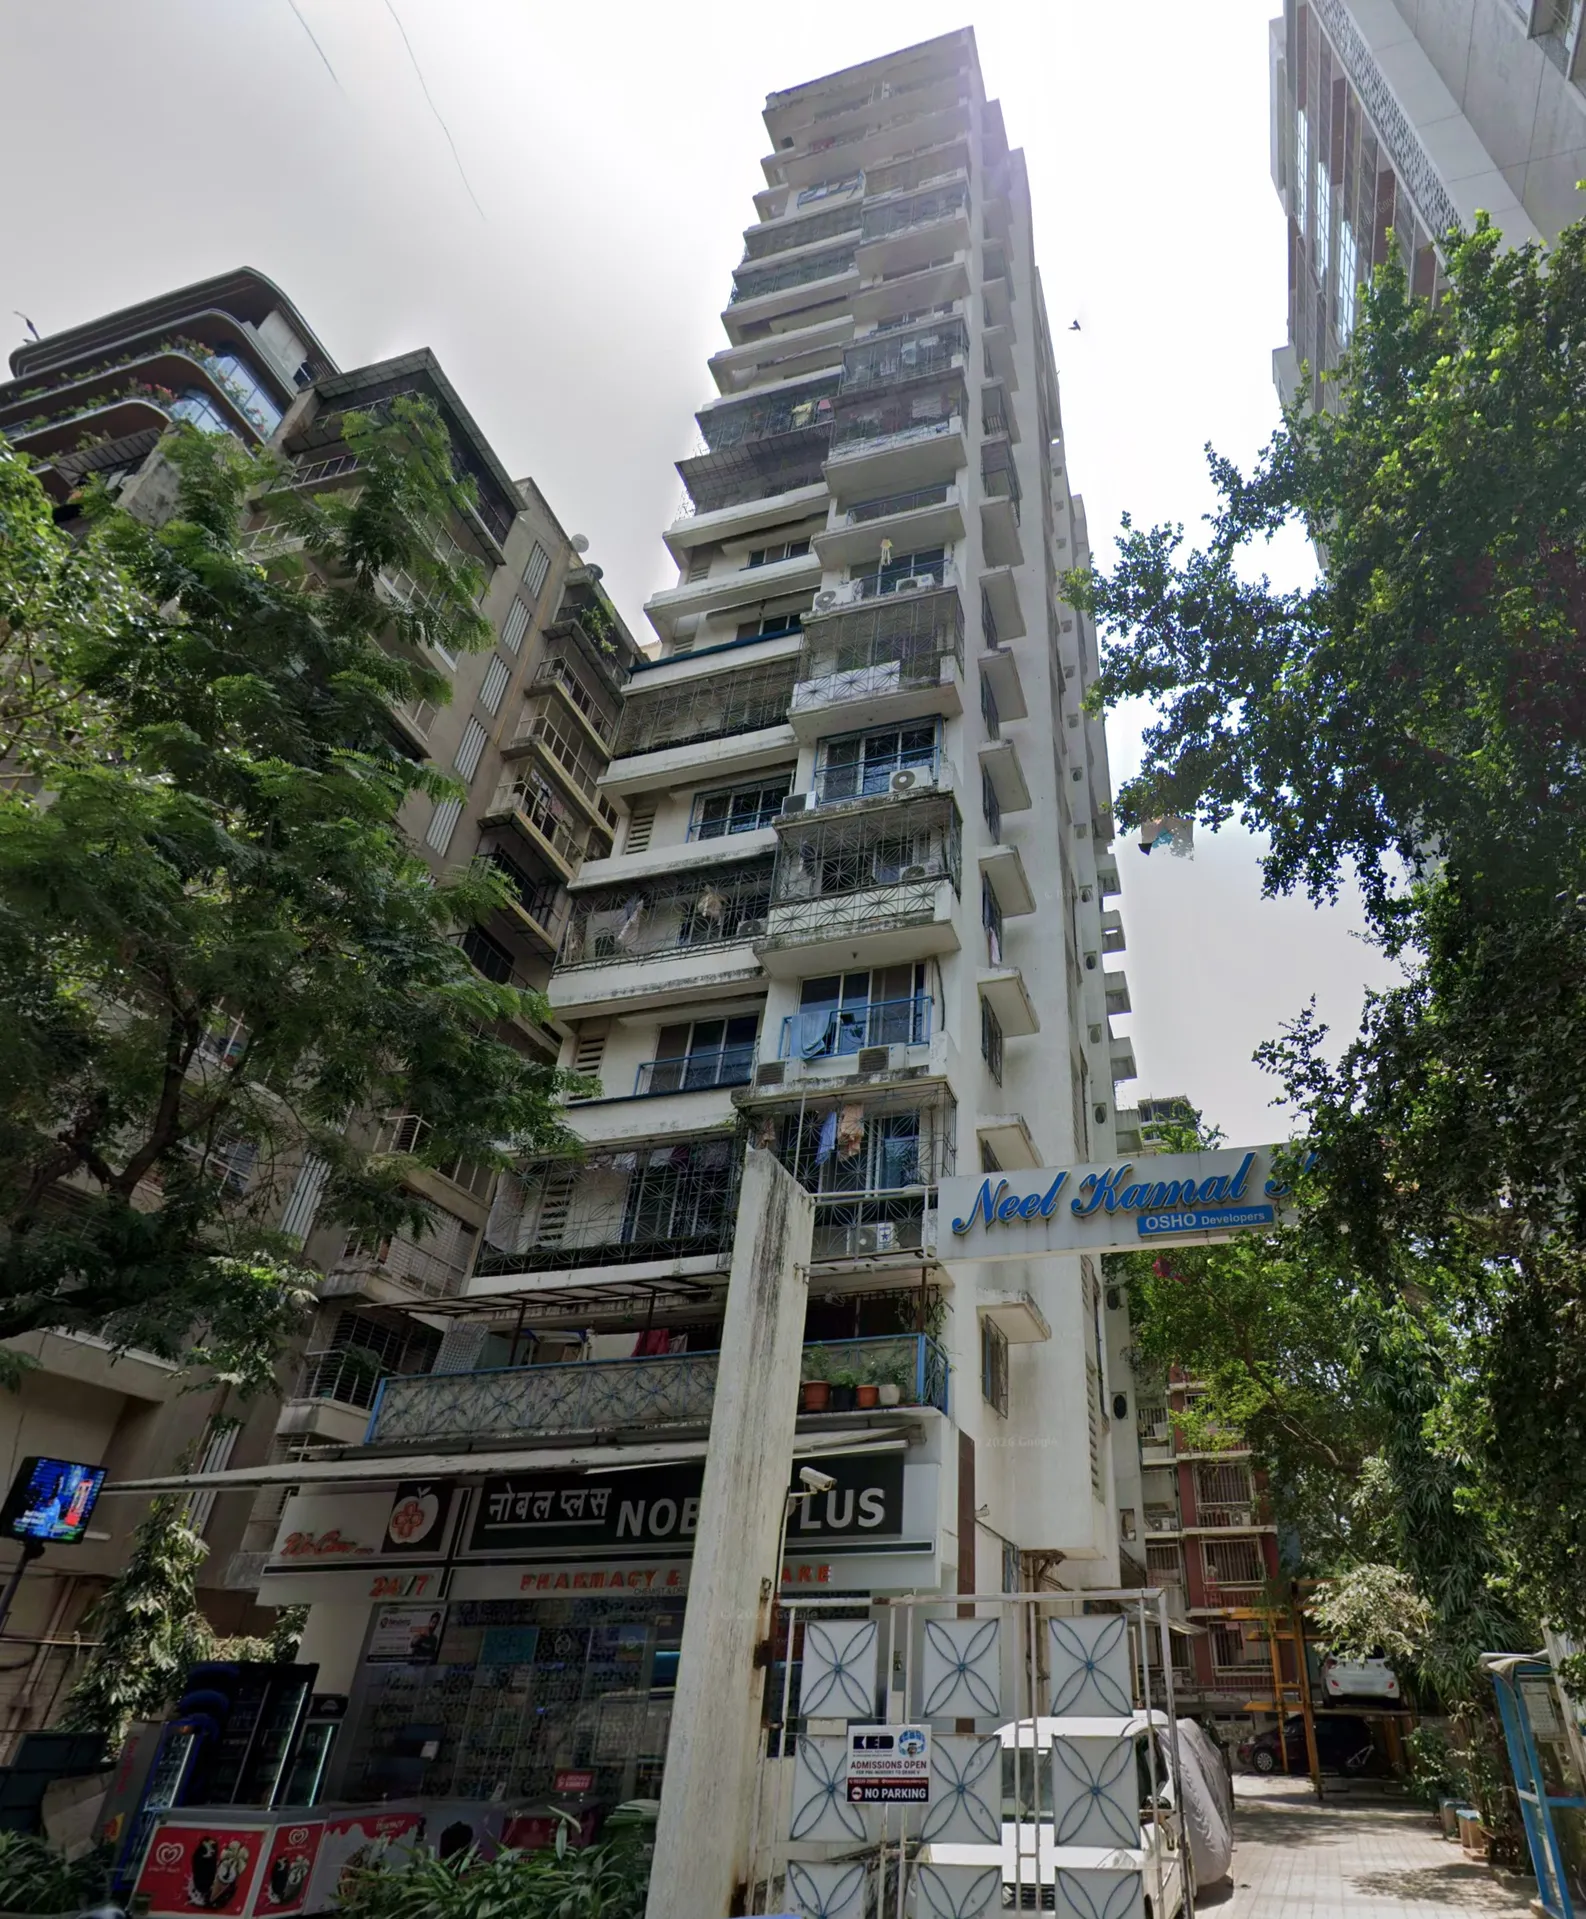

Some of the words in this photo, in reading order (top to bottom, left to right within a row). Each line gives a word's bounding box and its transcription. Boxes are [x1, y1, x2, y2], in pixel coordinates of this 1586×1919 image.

[952, 1170, 1071, 1235] Neel
[1071, 1152, 1257, 1218] Kamal
[1146, 1213, 1197, 1230] OSHO
[1201, 1212, 1265, 1226] Developers
[489, 1481, 555, 1521] नोबल
[560, 1487, 612, 1518] प्लस
[369, 1573, 430, 1598] 24/7
[519, 1568, 659, 1592] PHARMACY
[665, 1569, 682, 1586] &
[851, 1761, 902, 1769] ADMISSIONS
[904, 1760, 927, 1769] OPEN
[865, 1788, 879, 1798] NO
[881, 1788, 926, 1798] PARKING
